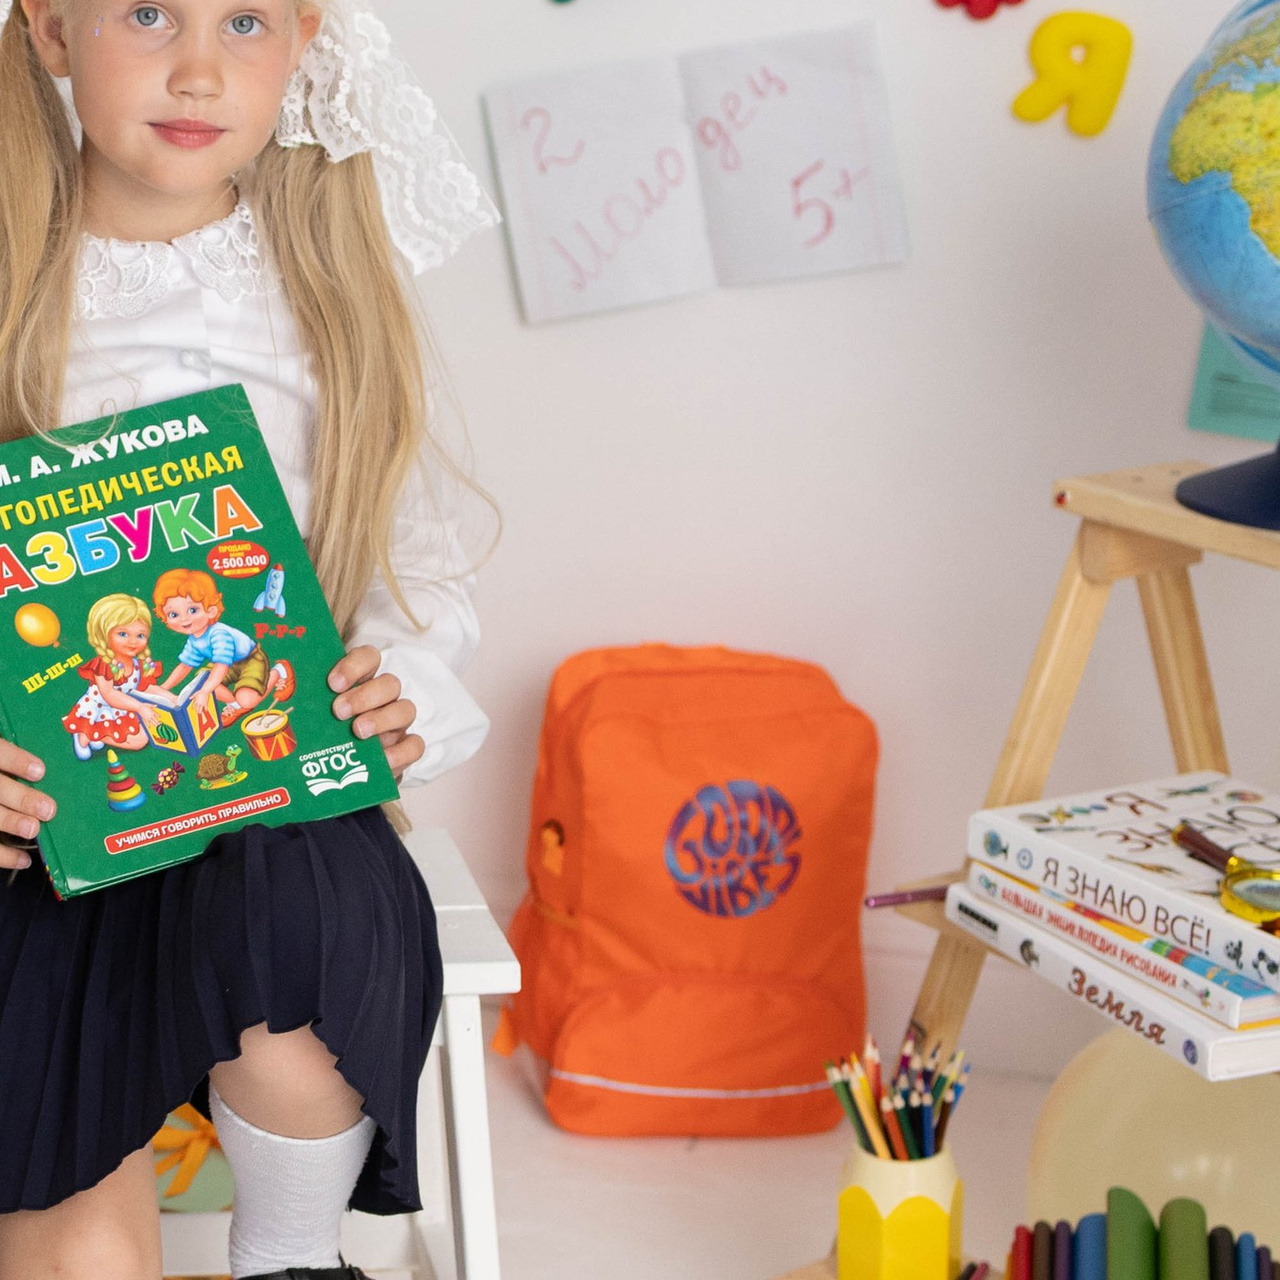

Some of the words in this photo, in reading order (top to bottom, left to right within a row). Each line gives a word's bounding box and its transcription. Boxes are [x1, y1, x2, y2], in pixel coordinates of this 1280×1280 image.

[1012, 11, 1133, 139] Я
[521, 107, 586, 173] 2
[30, 455, 61, 478] А.
[71, 414, 209, 468] ЖУКОВА
[212, 554, 267, 570] 2.500.000
[302, 749, 361, 777] ФГОС
[115, 828, 160, 848] УЧИМСЯ
[161, 813, 218, 835] ГОВОРИТЬ
[217, 793, 282, 819] ПРАВИЛЬНО
[1043, 857, 1060, 886] Я
[1065, 866, 1147, 925] ЗНАЮ
[1154, 906, 1211, 955] ВСЁ!
[1068, 967, 1166, 1044] Земля
